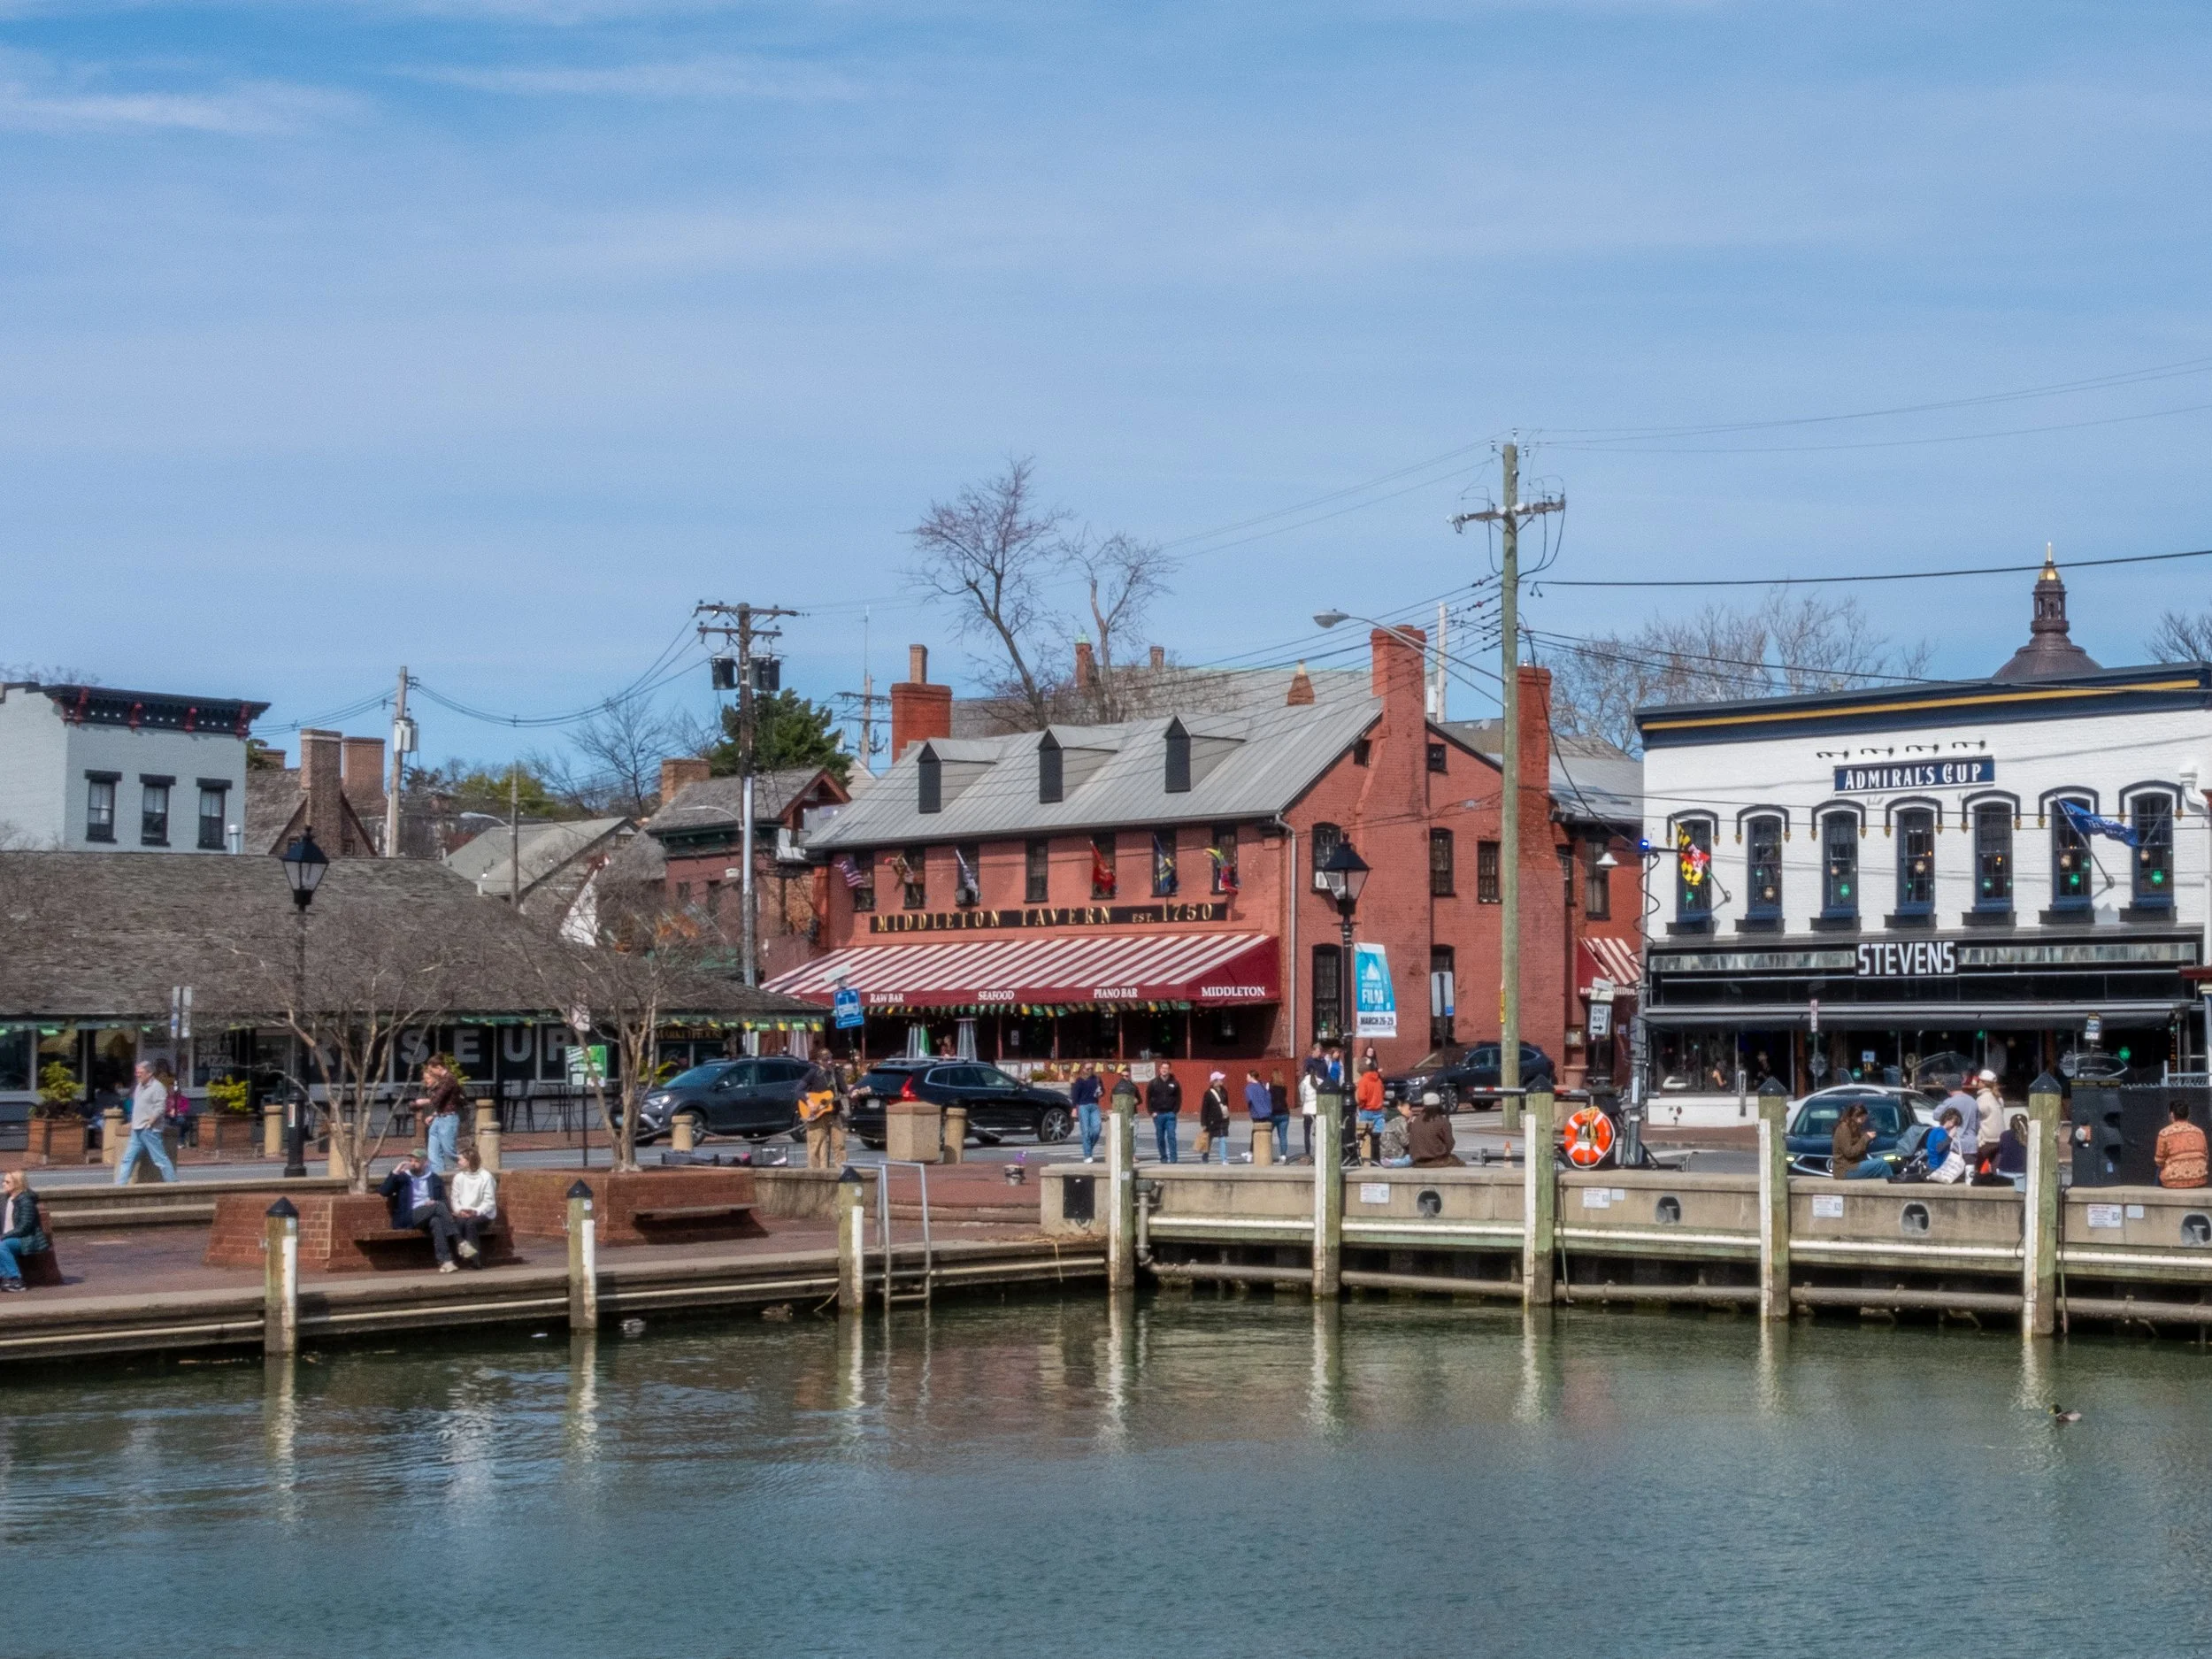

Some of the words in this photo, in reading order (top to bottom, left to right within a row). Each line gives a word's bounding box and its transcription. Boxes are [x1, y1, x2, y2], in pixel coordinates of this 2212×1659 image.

[1844, 766, 1936, 790] ADMIRAL'S
[1942, 763, 1982, 784] CUP
[877, 910, 1001, 932] MIDDLETON
[1020, 905, 1111, 926] TAVERN
[1132, 913, 1155, 923] EST.
[1162, 902, 1213, 922] 1750
[1858, 941, 1955, 975] STEVENS
[978, 990, 1015, 1001] SEAFOOD
[1094, 988, 1120, 999] PIANO
[1120, 987, 1138, 998] BAR
[1202, 986, 1266, 997] MIDDLETON
[1362, 987, 1384, 1004] FILM
[870, 993, 887, 1003] RAW
[888, 993, 904, 1002] BAR
[1360, 1017, 1379, 1025] MARCH
